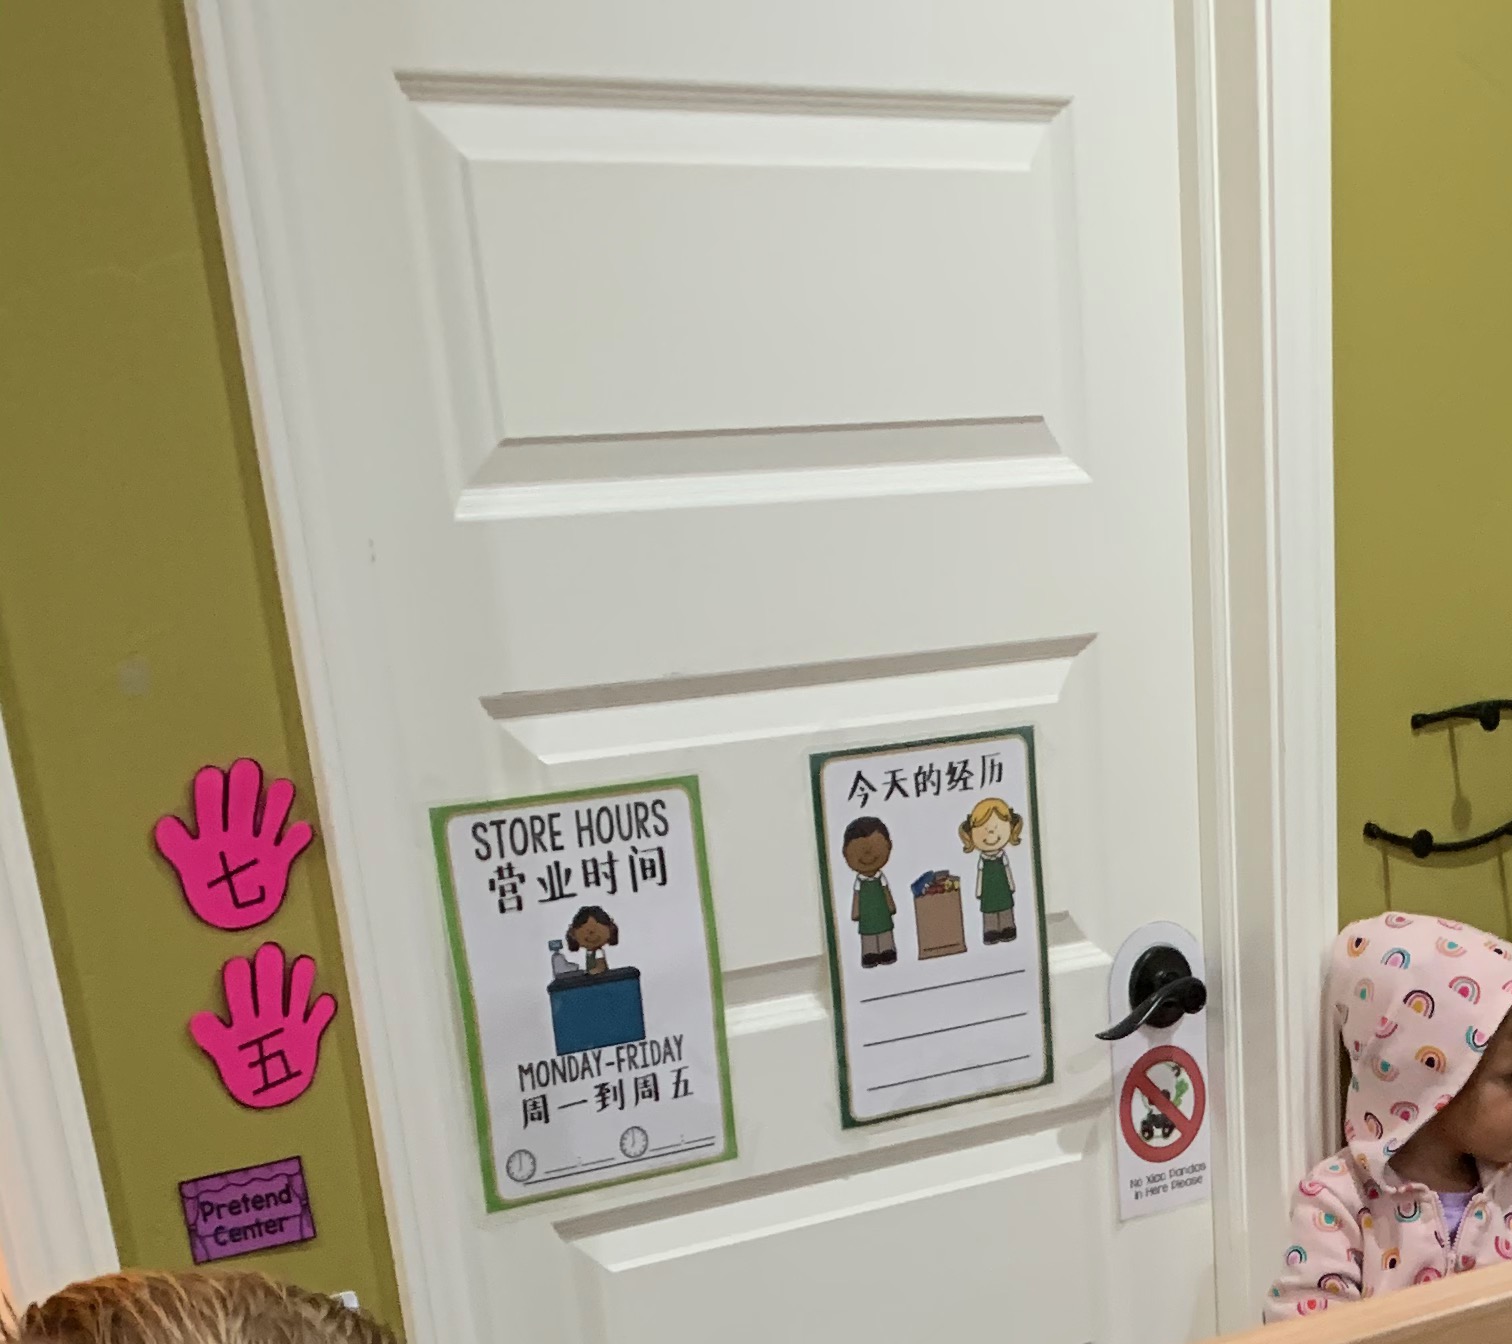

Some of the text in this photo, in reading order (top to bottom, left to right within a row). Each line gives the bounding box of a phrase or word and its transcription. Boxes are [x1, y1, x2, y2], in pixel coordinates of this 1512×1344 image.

[848, 752, 1004, 808] 今天的经历
[471, 799, 670, 861] STORE HOURS
[207, 851, 266, 909] 七
[488, 846, 669, 914] 营业时间
[238, 1028, 302, 1097] 五
[518, 1034, 685, 1092] MONDAY-FRIDAY
[523, 1066, 694, 1130] 周一到周五
[201, 1183, 293, 1224] Pretend
[213, 1215, 290, 1248] Center
